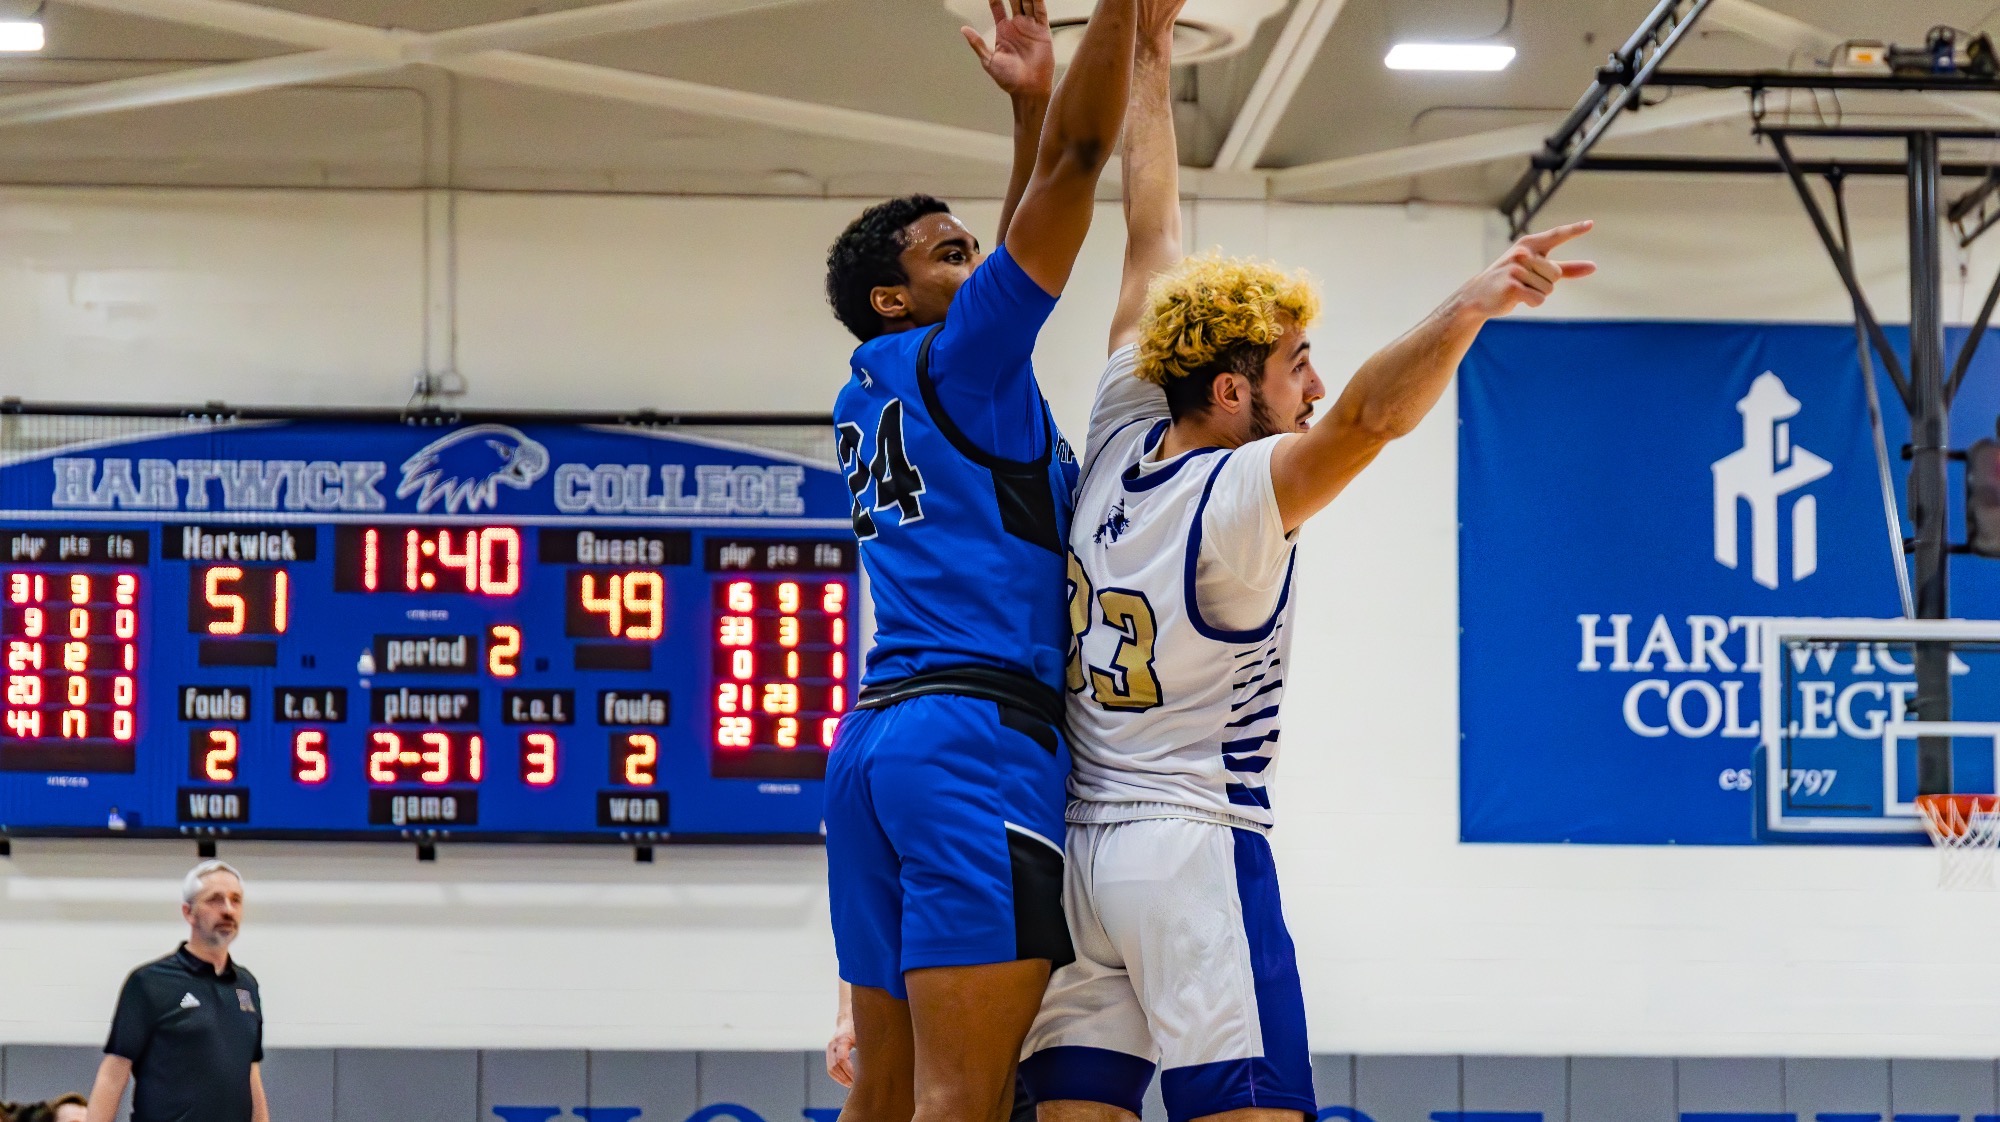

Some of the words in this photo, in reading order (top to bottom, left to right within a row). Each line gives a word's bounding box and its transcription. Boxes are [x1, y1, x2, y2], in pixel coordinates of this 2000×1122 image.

[52, 458, 386, 511] HARTWICK
[554, 464, 805, 515] COLLEGE
[836, 397, 926, 544] 24
[183, 526, 297, 560] Hartwick
[576, 532, 665, 564] Guests
[365, 528, 518, 594] 11:40
[11, 573, 43, 603] 31
[116, 574, 134, 605] 2
[206, 567, 287, 634] 51
[581, 571, 663, 639] 49
[779, 582, 798, 612] 9
[823, 583, 843, 612] 2
[25, 607, 43, 637] 9
[70, 608, 89, 638] 0
[116, 609, 134, 638] 0
[720, 616, 752, 645] 33
[779, 616, 798, 647] 3
[833, 617, 843, 645] 1
[9, 641, 41, 671] 24
[124, 643, 133, 671] 1
[387, 635, 467, 671] period
[490, 626, 520, 677] 2
[733, 650, 752, 679] 0
[787, 651, 798, 678] 1
[833, 652, 843, 678] 1
[8, 675, 41, 704] 20
[68, 675, 87, 705] 0
[114, 676, 132, 706] 0
[184, 688, 246, 720] fouls
[384, 688, 468, 724] player
[718, 683, 752, 713] 21
[763, 684, 798, 713] 23
[833, 685, 843, 712] 1
[604, 692, 665, 723] fouls
[7, 709, 40, 738] 44
[113, 710, 132, 740] 0
[718, 716, 752, 746] 22
[777, 717, 797, 747] 2
[206, 731, 236, 781] 2
[297, 731, 326, 781] 5
[370, 732, 481, 782] 2-31
[526, 733, 554, 784] 3
[625, 733, 656, 785] 2
[189, 794, 241, 819] won
[391, 796, 458, 826] game
[609, 797, 660, 823] won
